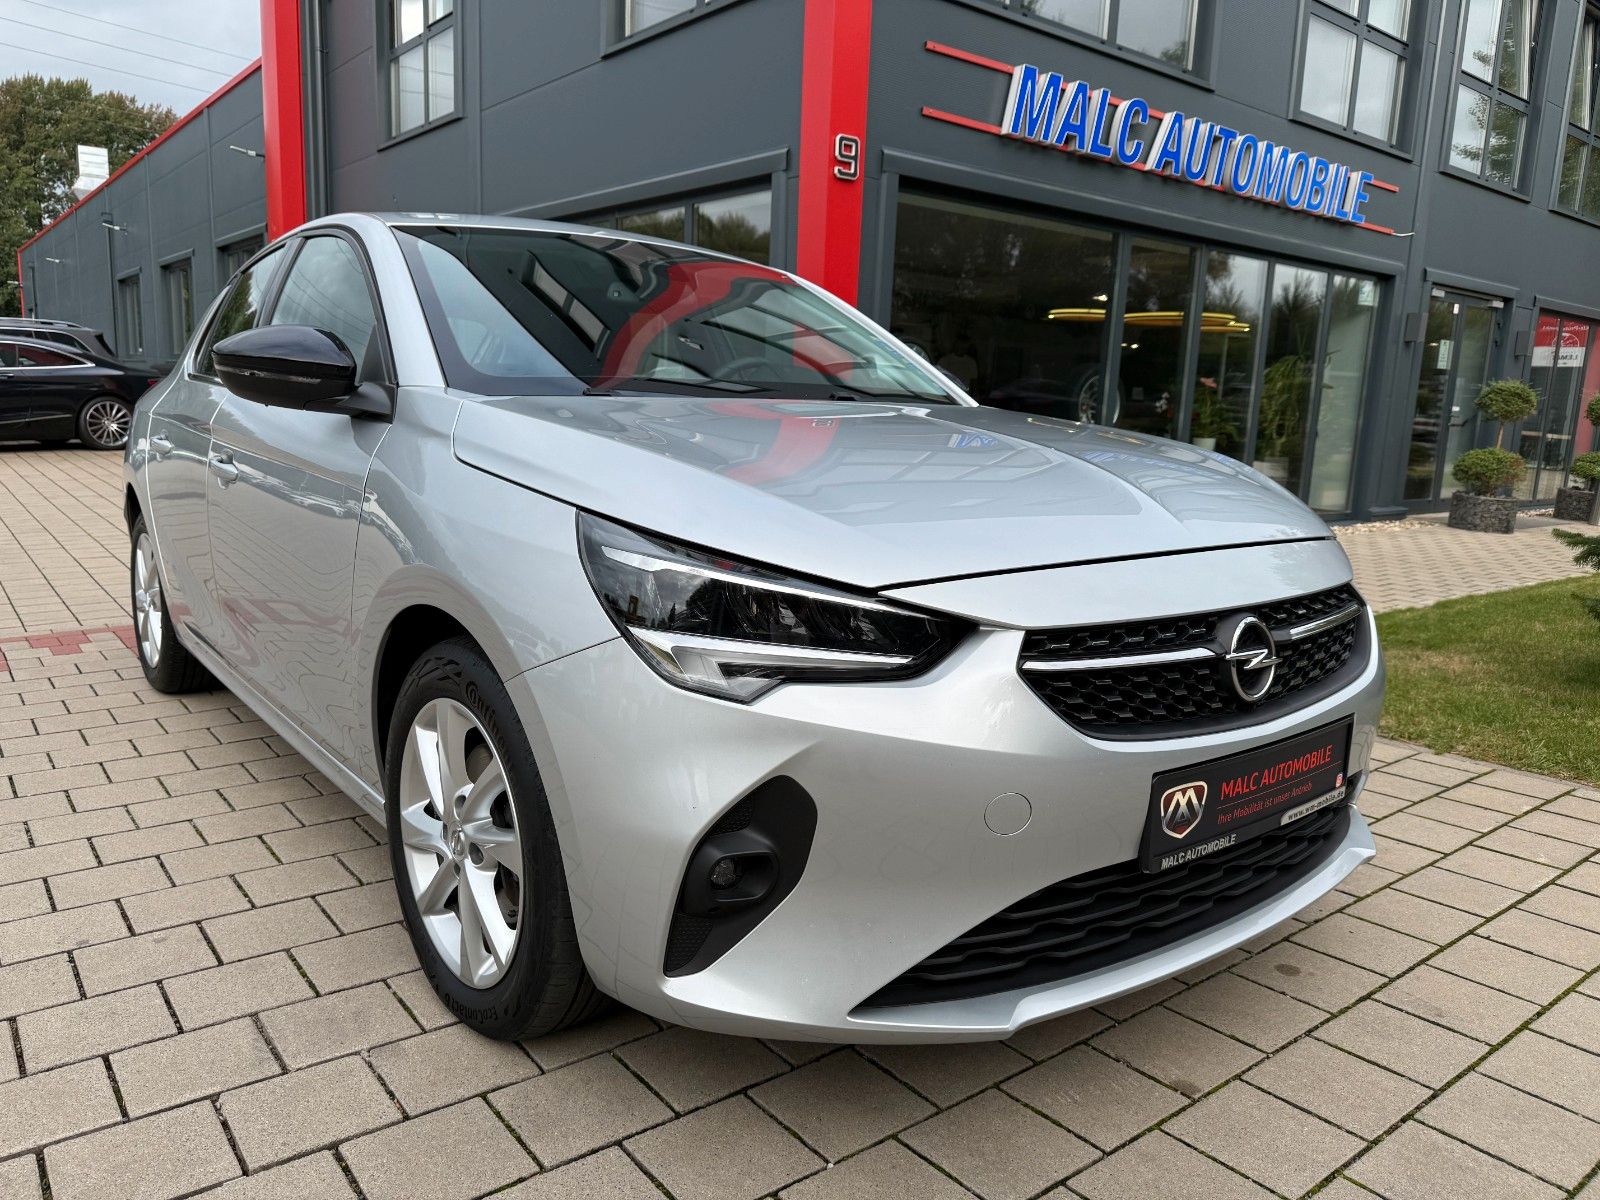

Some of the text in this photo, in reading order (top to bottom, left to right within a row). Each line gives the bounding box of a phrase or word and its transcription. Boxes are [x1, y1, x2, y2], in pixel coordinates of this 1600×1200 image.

[834, 133, 861, 181] 9
[1004, 63, 1375, 224] MALC AUTOMOBILE
[1220, 772, 1259, 801] MALC
[1260, 745, 1334, 788] AUTOMOBILE
[1217, 782, 1313, 825] Ihre Mobilität ist unser Antrieb
[1160, 833, 1237, 870] MALC AUTOMOBILE
